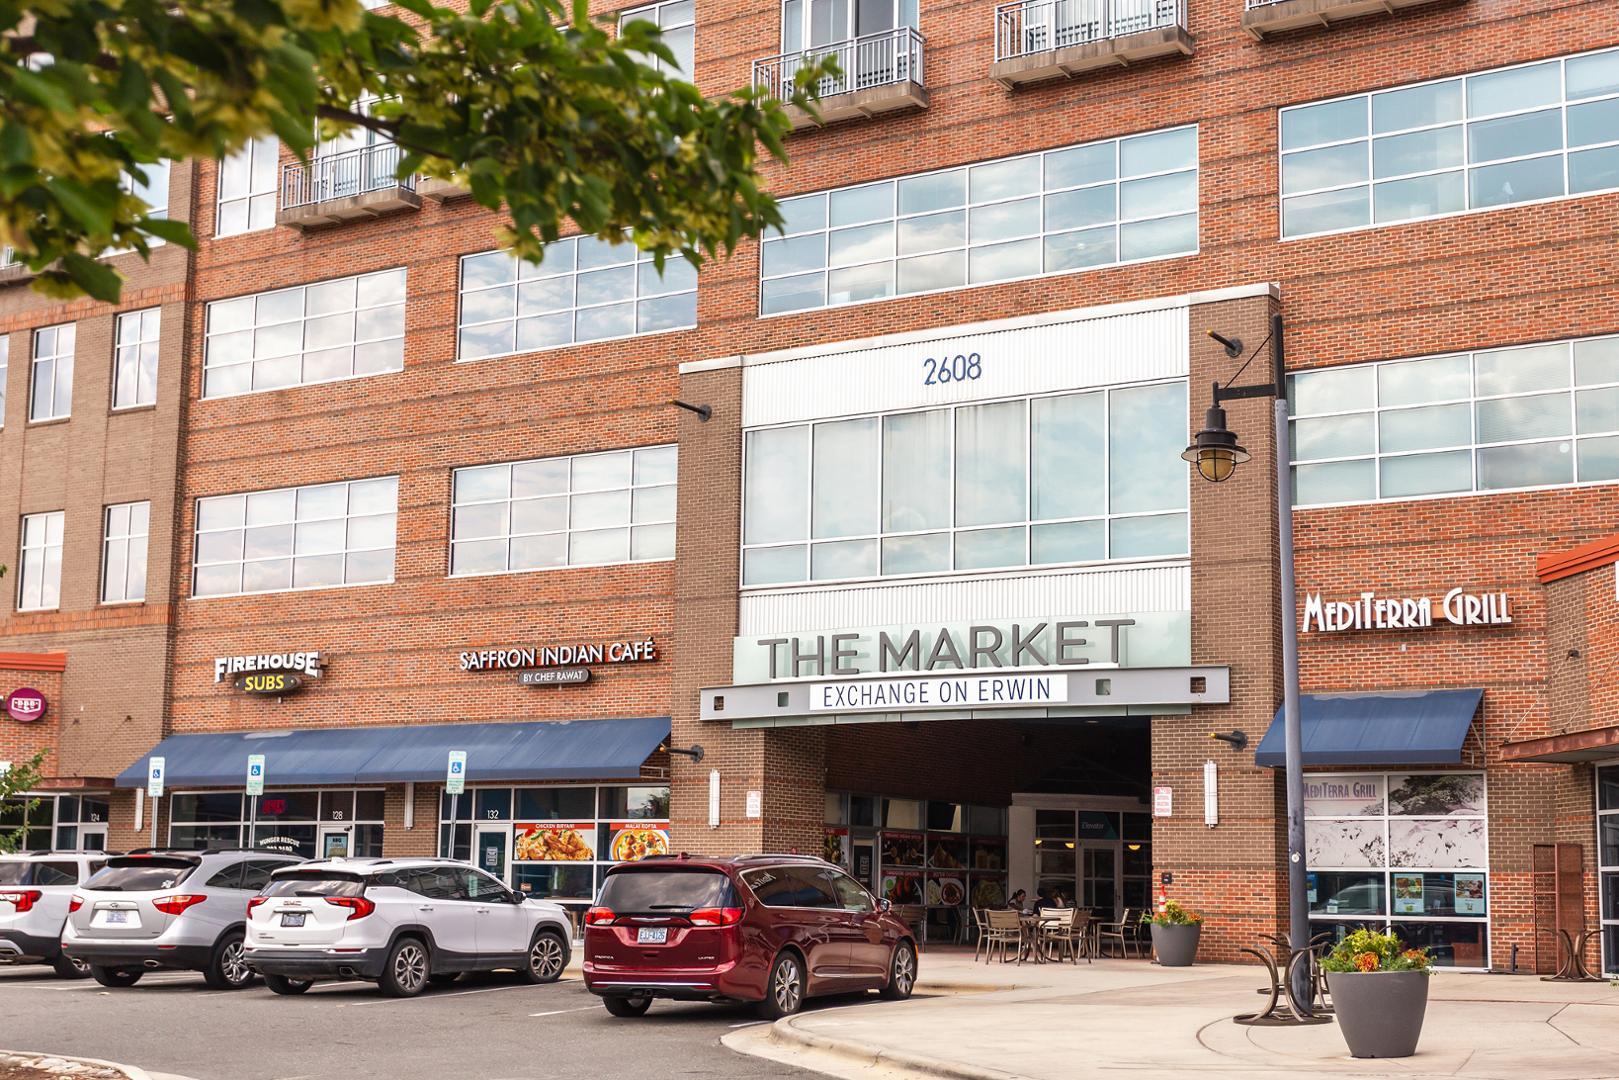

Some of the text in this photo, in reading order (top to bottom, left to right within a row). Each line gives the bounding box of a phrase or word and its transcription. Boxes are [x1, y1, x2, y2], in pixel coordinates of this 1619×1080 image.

[923, 352, 982, 386] 2608
[459, 636, 654, 671] SAFFRON INDIAN CAFÉ
[757, 618, 1137, 679] THE MARKET
[213, 651, 320, 683] FIREHOUSE
[523, 670, 583, 682] BY CHEF RAWAT
[244, 675, 285, 691] SUBS
[823, 677, 1051, 708] EXCHANGE ON ERWIN
[90, 813, 100, 822] 124
[332, 810, 343, 820] 128
[487, 810, 499, 820] 132
